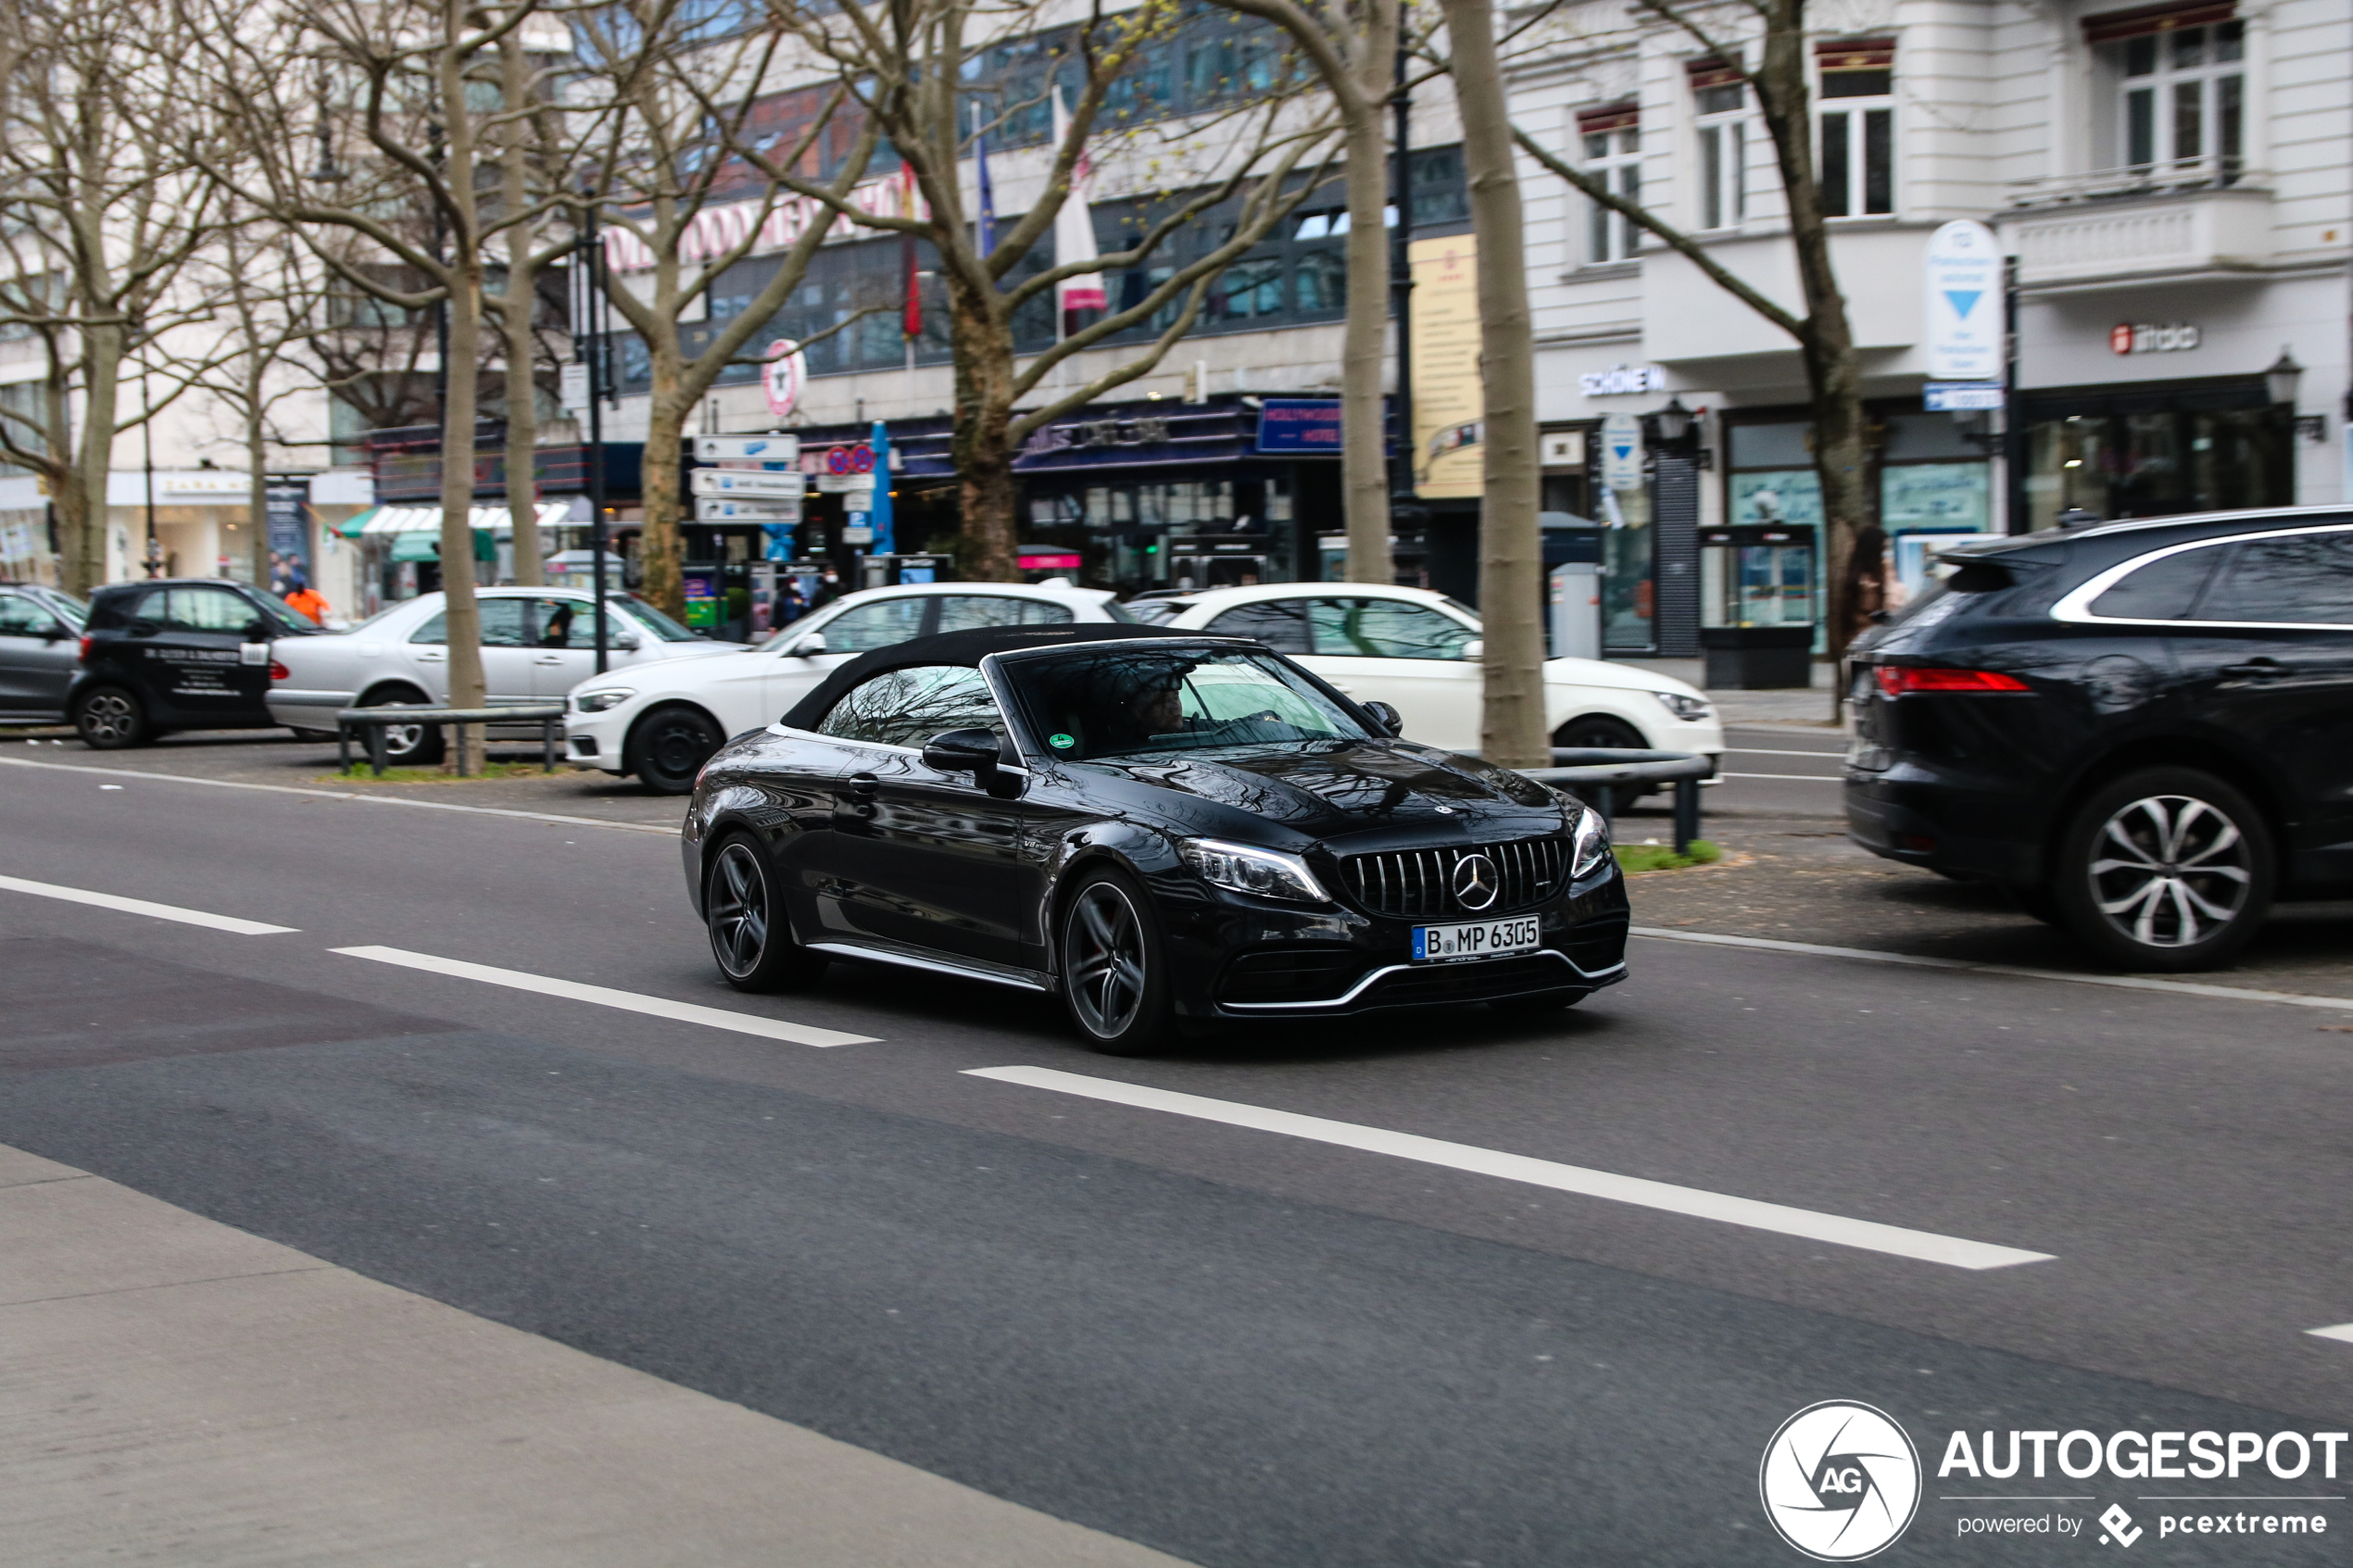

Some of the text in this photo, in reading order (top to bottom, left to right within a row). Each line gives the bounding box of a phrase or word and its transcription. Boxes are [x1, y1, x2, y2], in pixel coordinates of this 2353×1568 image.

[1428, 920, 1537, 954] B MP 6305
